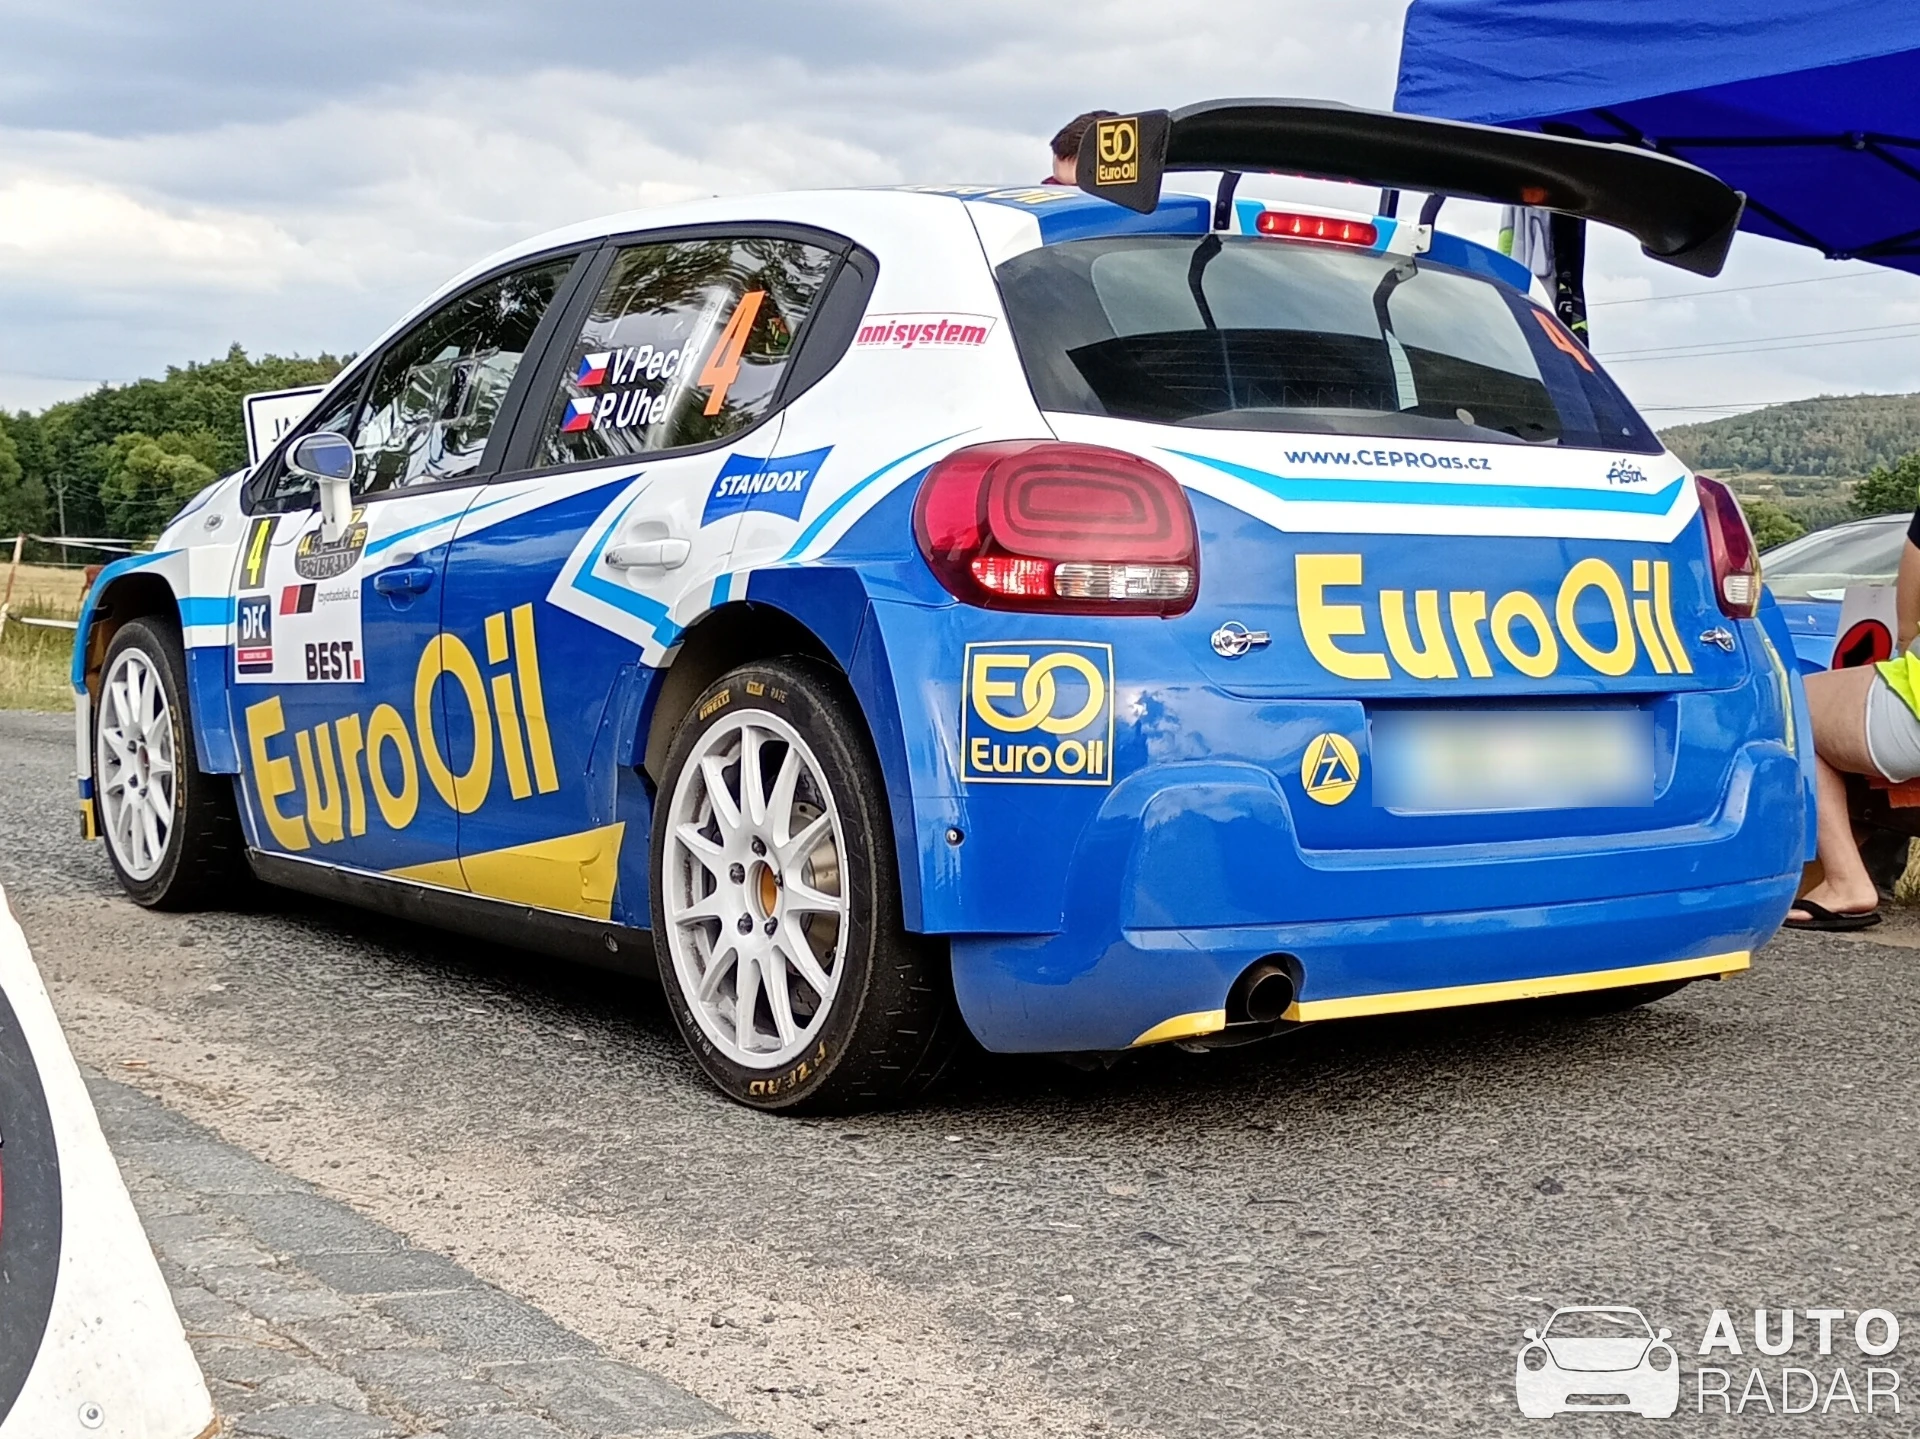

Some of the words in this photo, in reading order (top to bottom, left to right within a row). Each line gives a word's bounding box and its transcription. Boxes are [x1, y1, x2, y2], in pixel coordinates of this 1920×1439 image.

[697, 290, 766, 416] 4
[1530, 308, 1595, 373] 4
[715, 469, 810, 498] STANDOX
[1284, 449, 1492, 471] www.CEPROas.cz
[246, 518, 272, 586] 4
[242, 604, 267, 640] DFC
[1295, 553, 1694, 680] EuroOil
[245, 602, 560, 851] EuroOil
